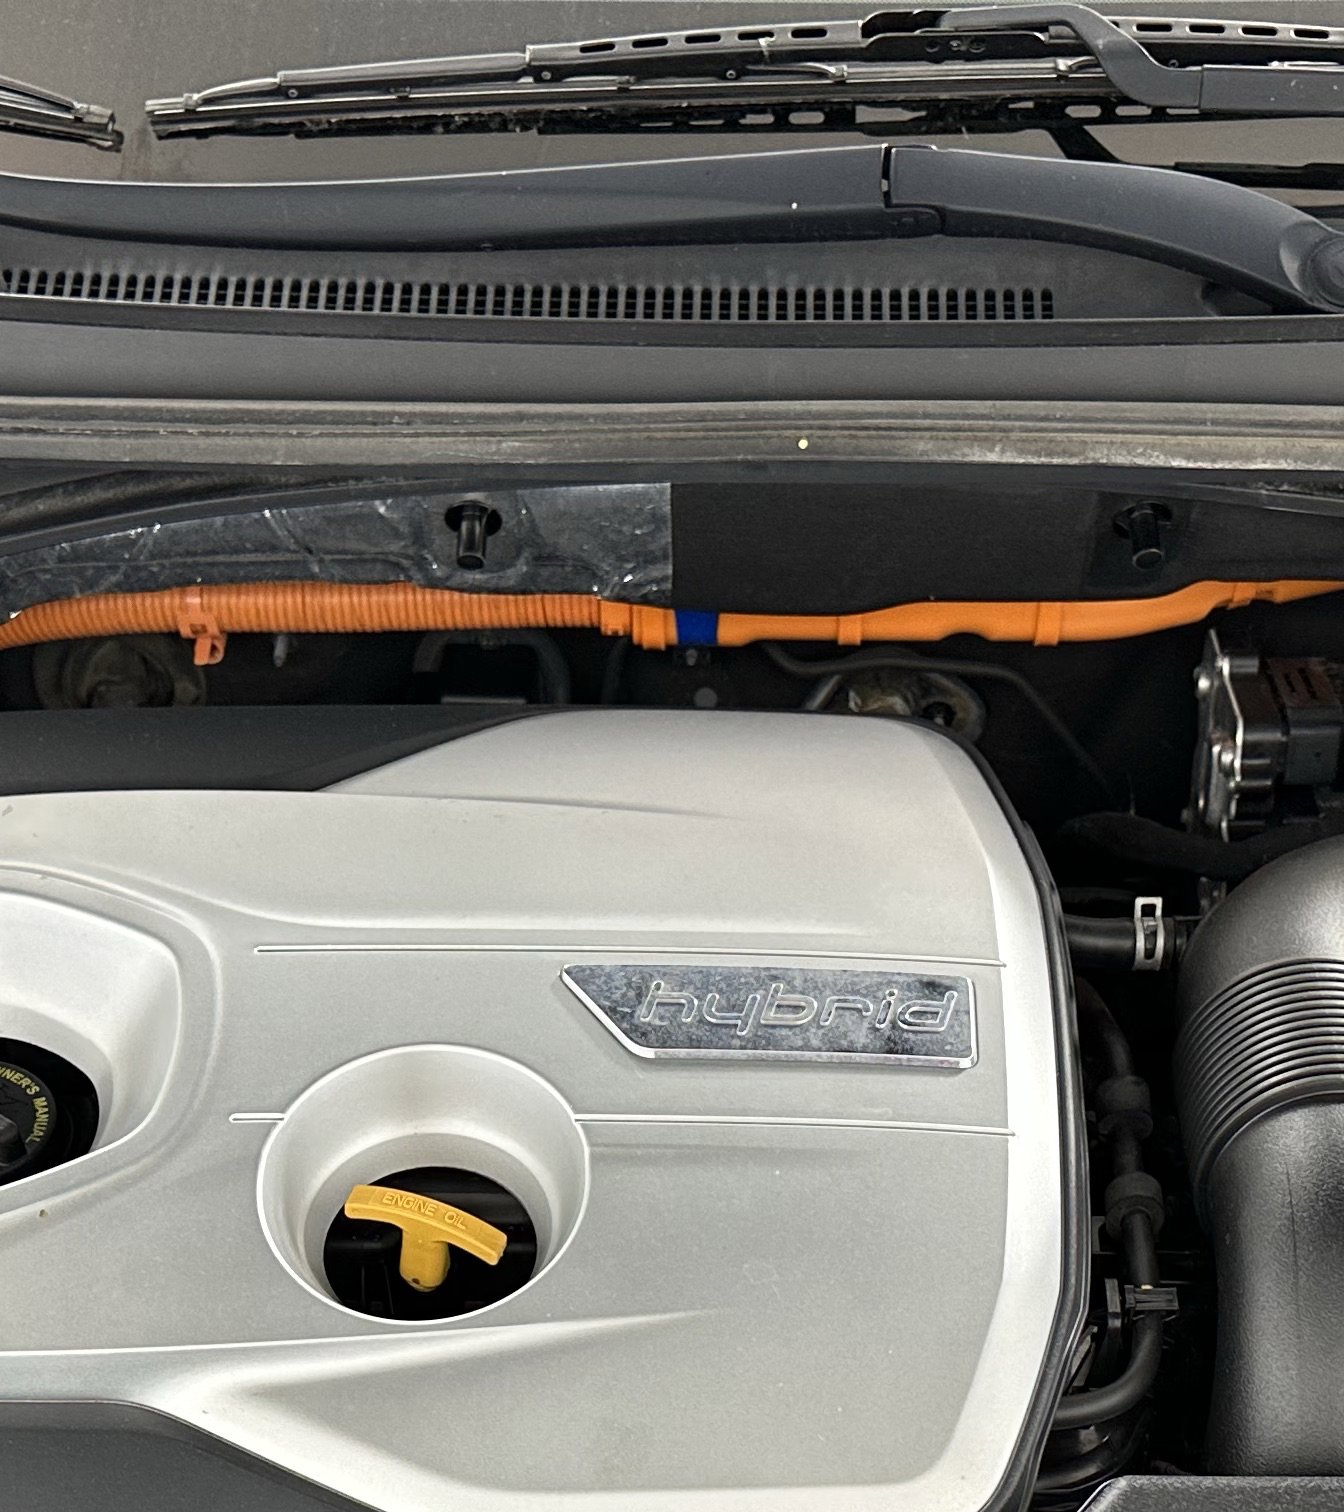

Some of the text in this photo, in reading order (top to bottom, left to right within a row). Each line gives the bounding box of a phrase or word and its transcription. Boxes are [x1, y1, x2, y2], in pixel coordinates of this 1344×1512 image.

[638, 979, 958, 1036] hybrid
[25, 1096, 50, 1144] MANUAL
[381, 1191, 467, 1230] ENGINE OIL
